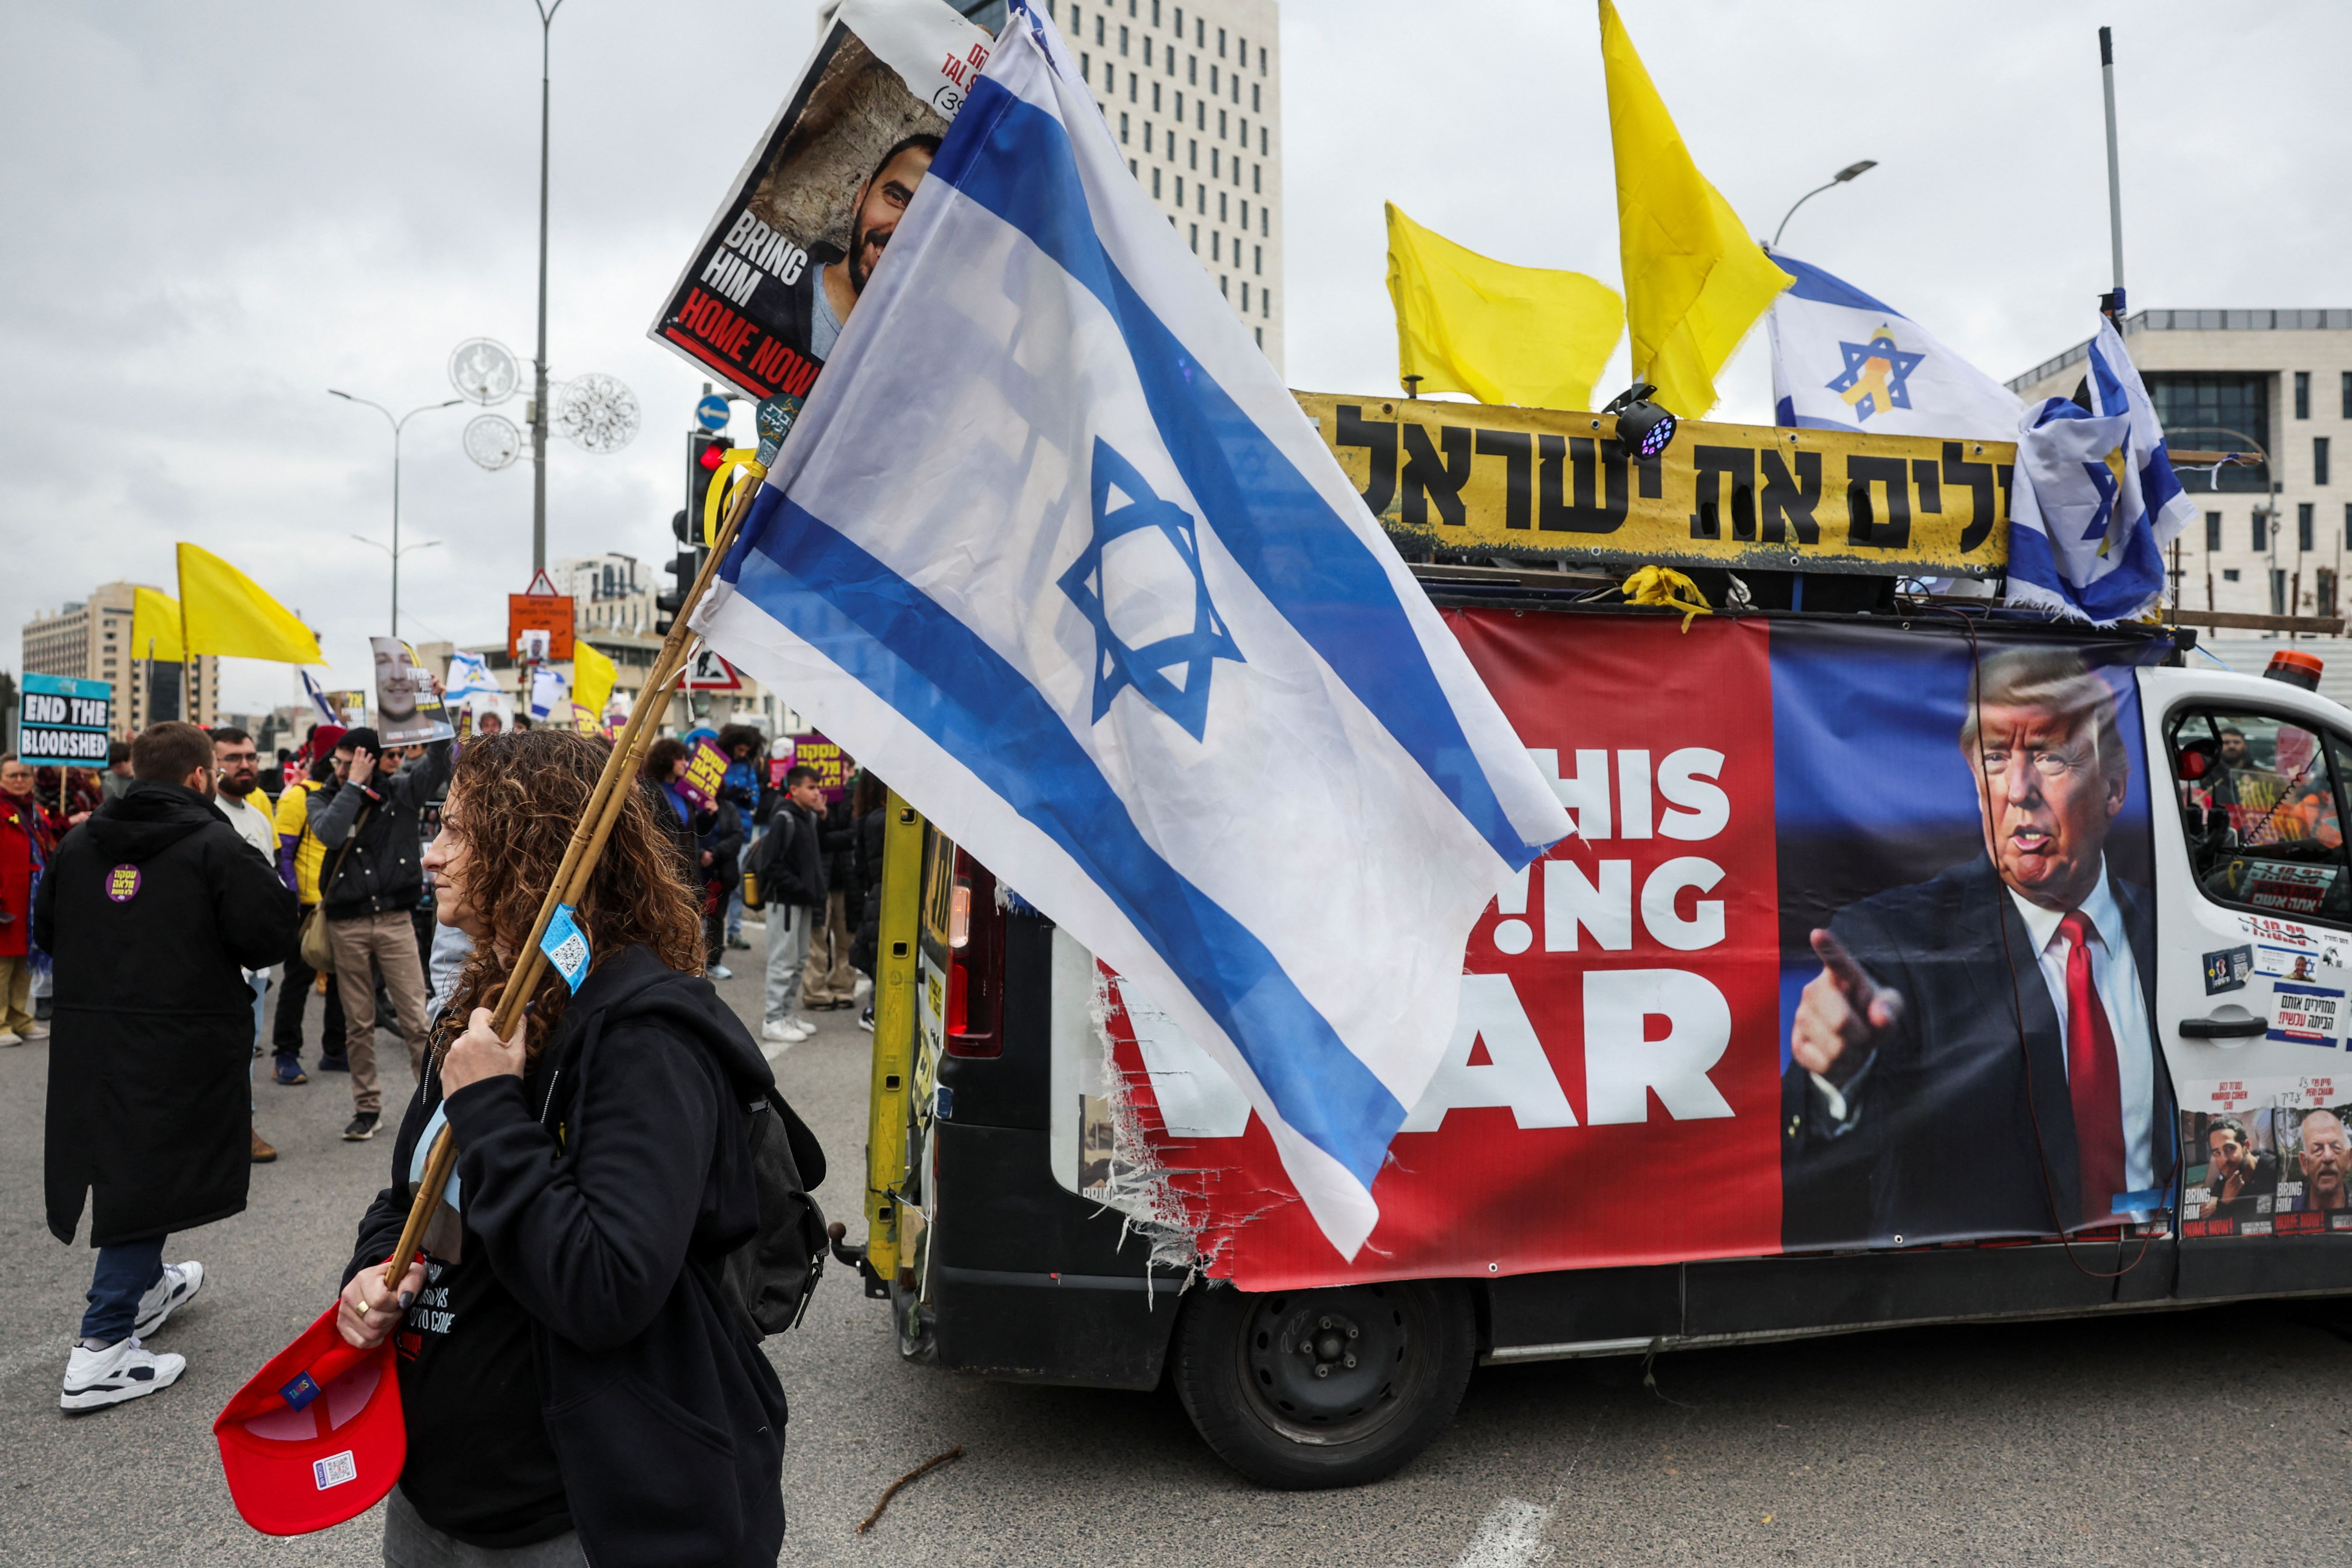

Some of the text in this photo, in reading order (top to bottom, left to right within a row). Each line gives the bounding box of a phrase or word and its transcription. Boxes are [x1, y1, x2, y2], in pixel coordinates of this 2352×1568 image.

[941, 53, 967, 87] TAL
[724, 209, 808, 286] BRING
[700, 246, 763, 308] HIM
[678, 287, 820, 397] HOME NOW
[1336, 405, 1662, 534] ישראל
[1690, 445, 1823, 544] את
[24, 694, 106, 726] END THE
[21, 729, 106, 757] BLOODSHED
[797, 744, 841, 761] עסקה
[2252, 893, 2317, 912] אתה אשם
[2281, 995, 2336, 1014] מחזירים אותם
[2308, 1015, 2334, 1030] הביתה
[2185, 1187, 2211, 1204] BRING
[2277, 1181, 2303, 1197] BRING
[2184, 1204, 2201, 1220] HIM
[2275, 1197, 2293, 1213] HIM
[2183, 1221, 2207, 1237] HOME
[2208, 1217, 2234, 1235] NOW!
[2275, 1214, 2299, 1230] HOME
[2300, 1211, 2325, 1228] NOW!
